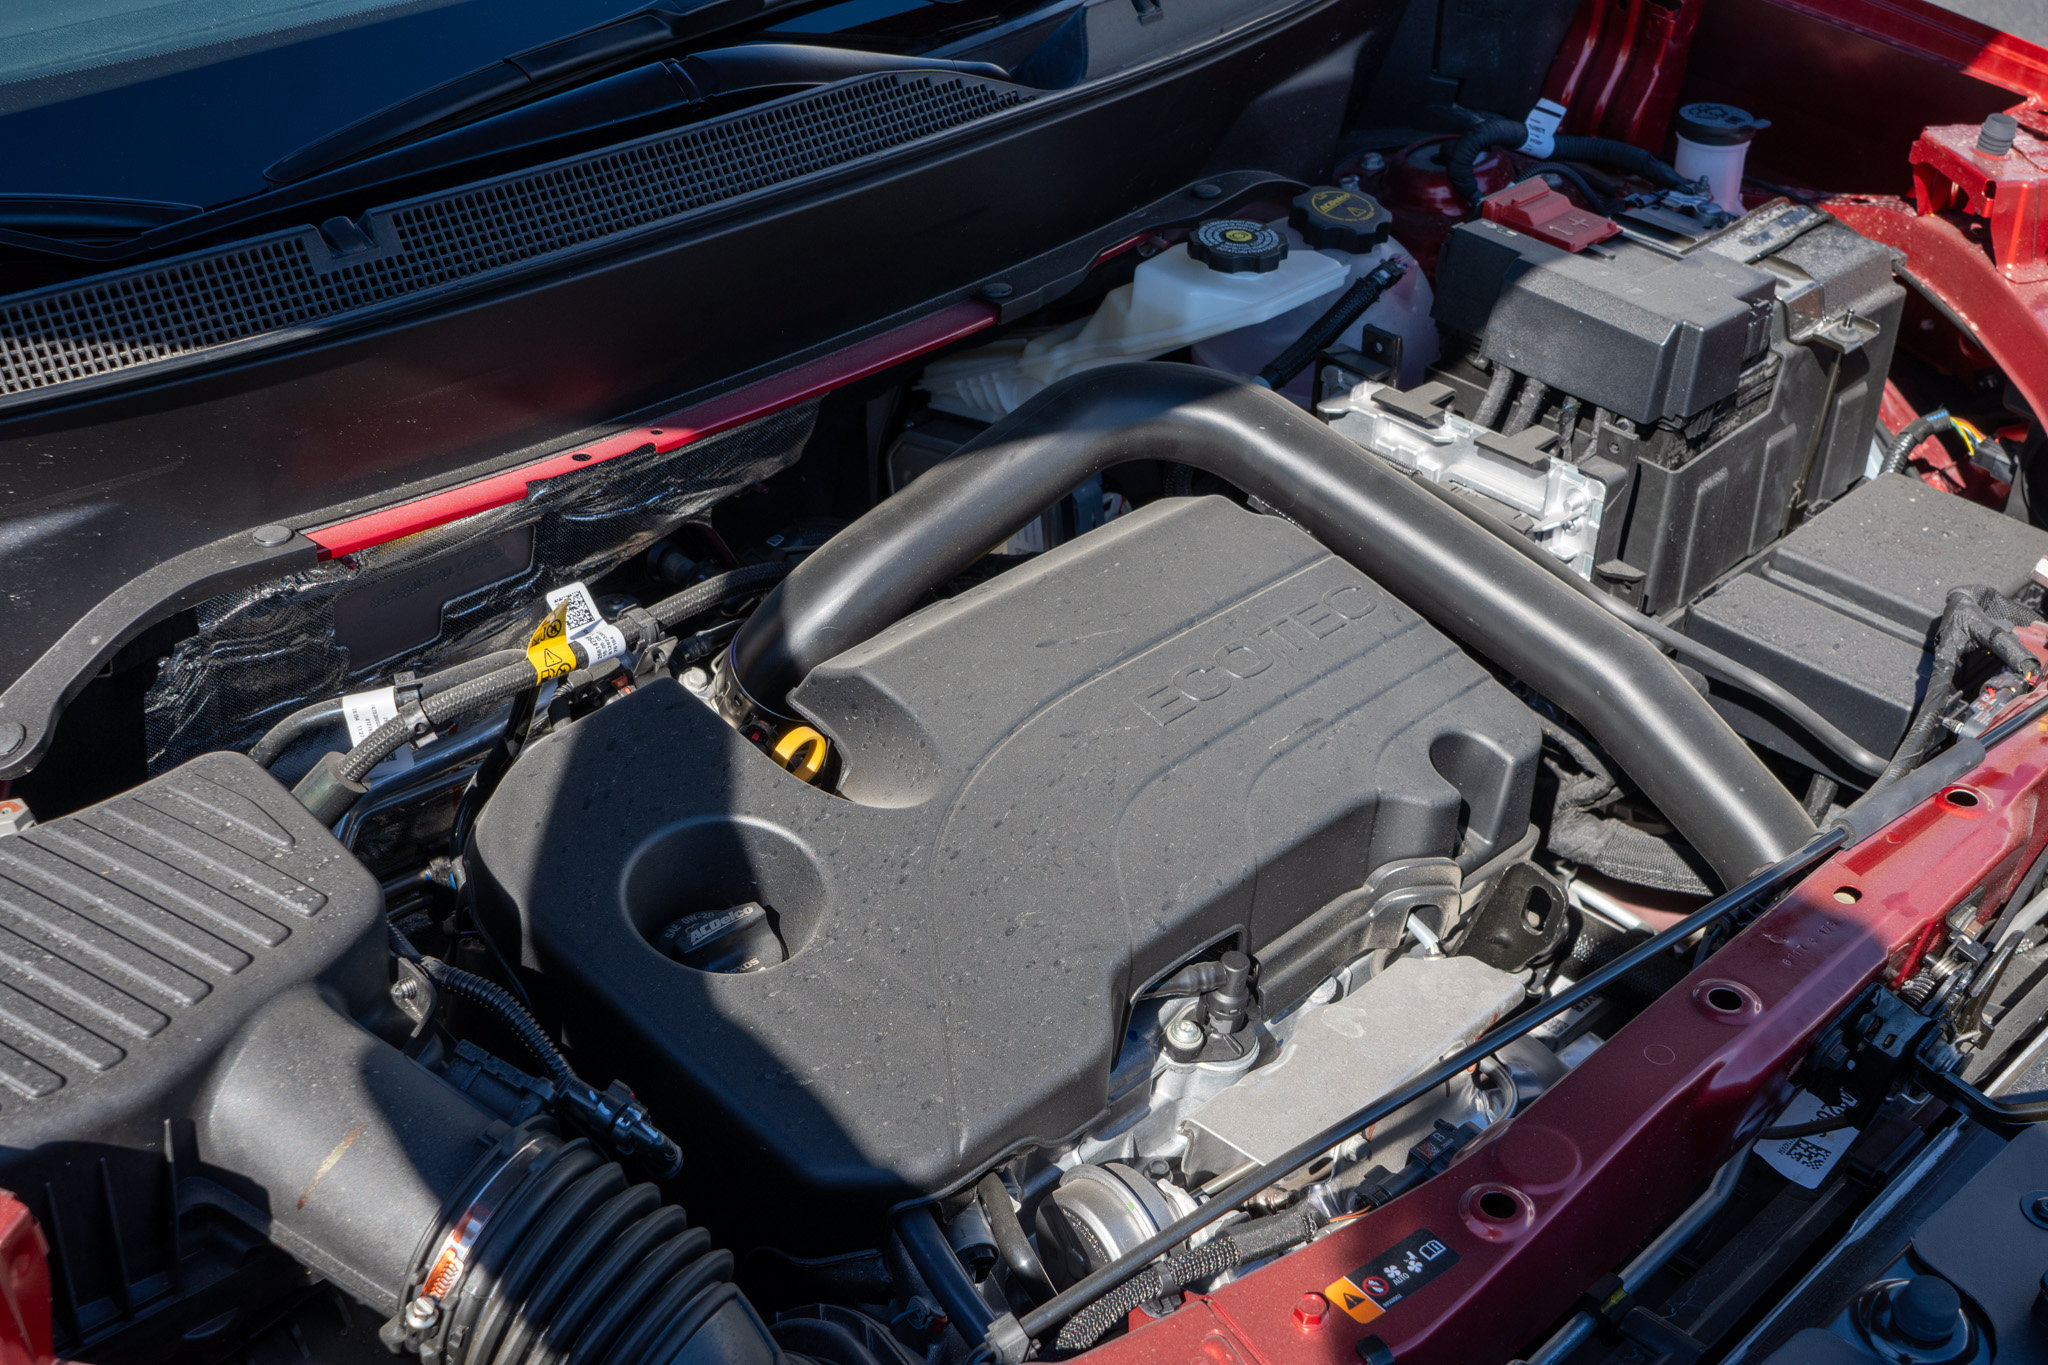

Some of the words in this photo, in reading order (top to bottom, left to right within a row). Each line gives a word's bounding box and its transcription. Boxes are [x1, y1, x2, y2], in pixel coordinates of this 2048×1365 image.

[1132, 586, 1377, 726] ECOTEC
[664, 923, 682, 939] SAE
[690, 906, 755, 944] ACDelco
[1392, 1272, 1411, 1286] AUTO
